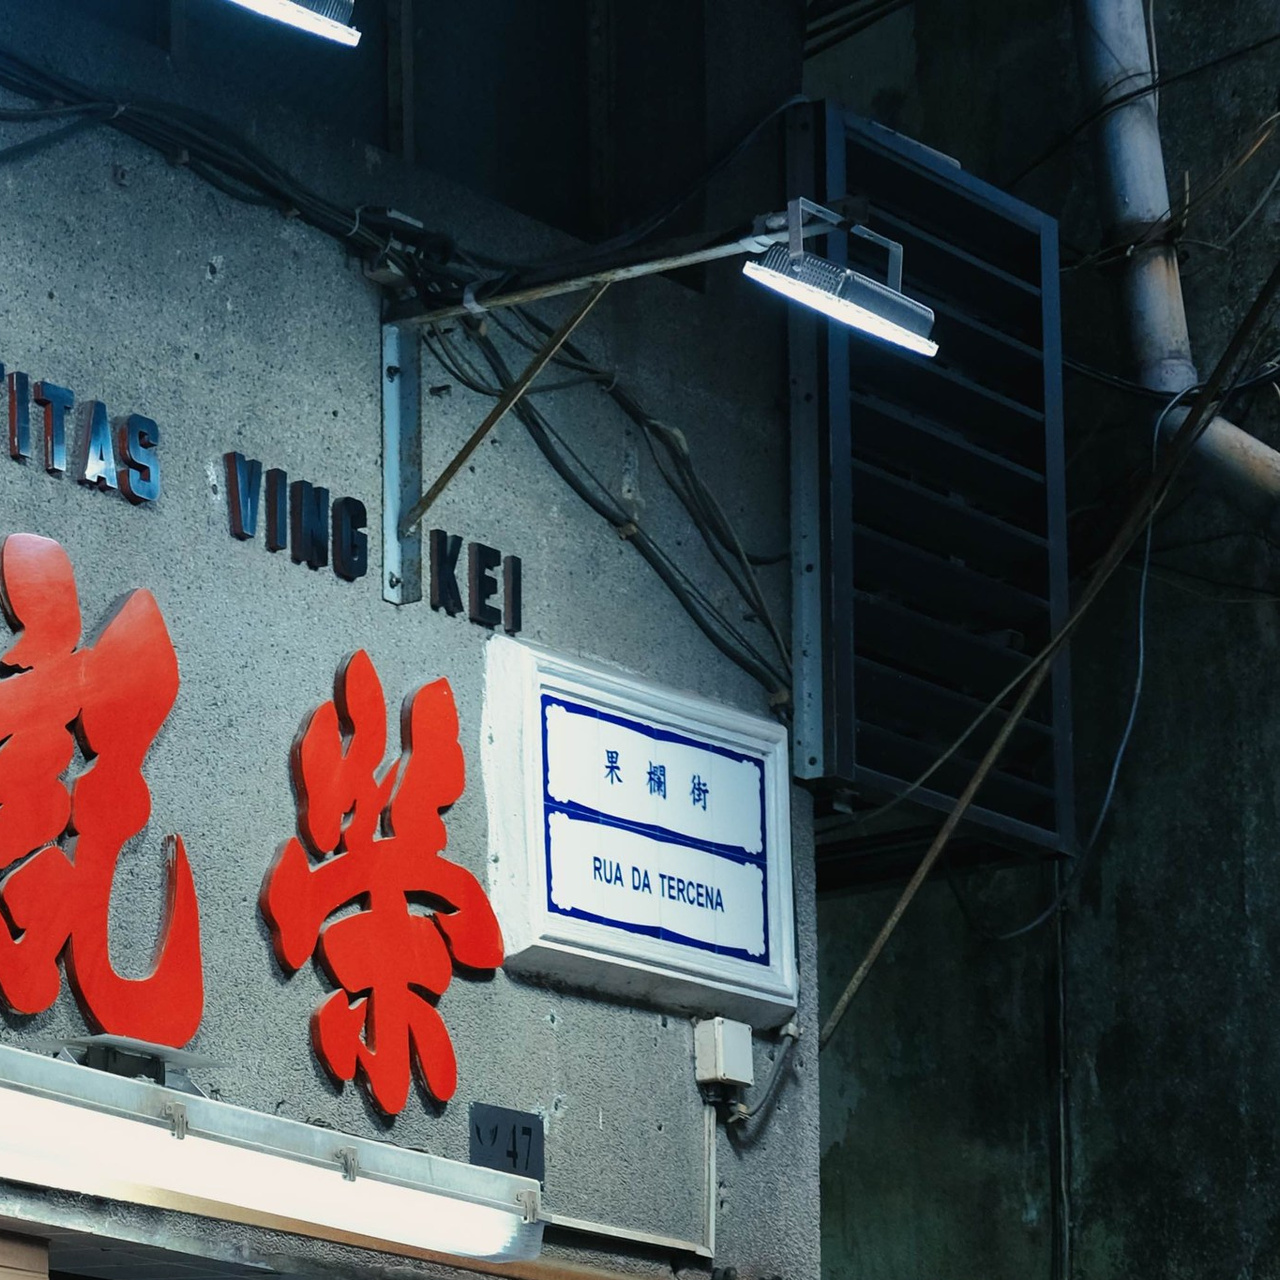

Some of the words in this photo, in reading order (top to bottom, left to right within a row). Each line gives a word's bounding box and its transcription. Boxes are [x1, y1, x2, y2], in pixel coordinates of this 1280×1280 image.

[223, 451, 368, 582] VING
[430, 529, 522, 633] KEI
[605, 749, 709, 812] 果欄街
[593, 856, 624, 887] RUA
[631, 867, 652, 894] DA
[659, 873, 725, 912] TERCENA
